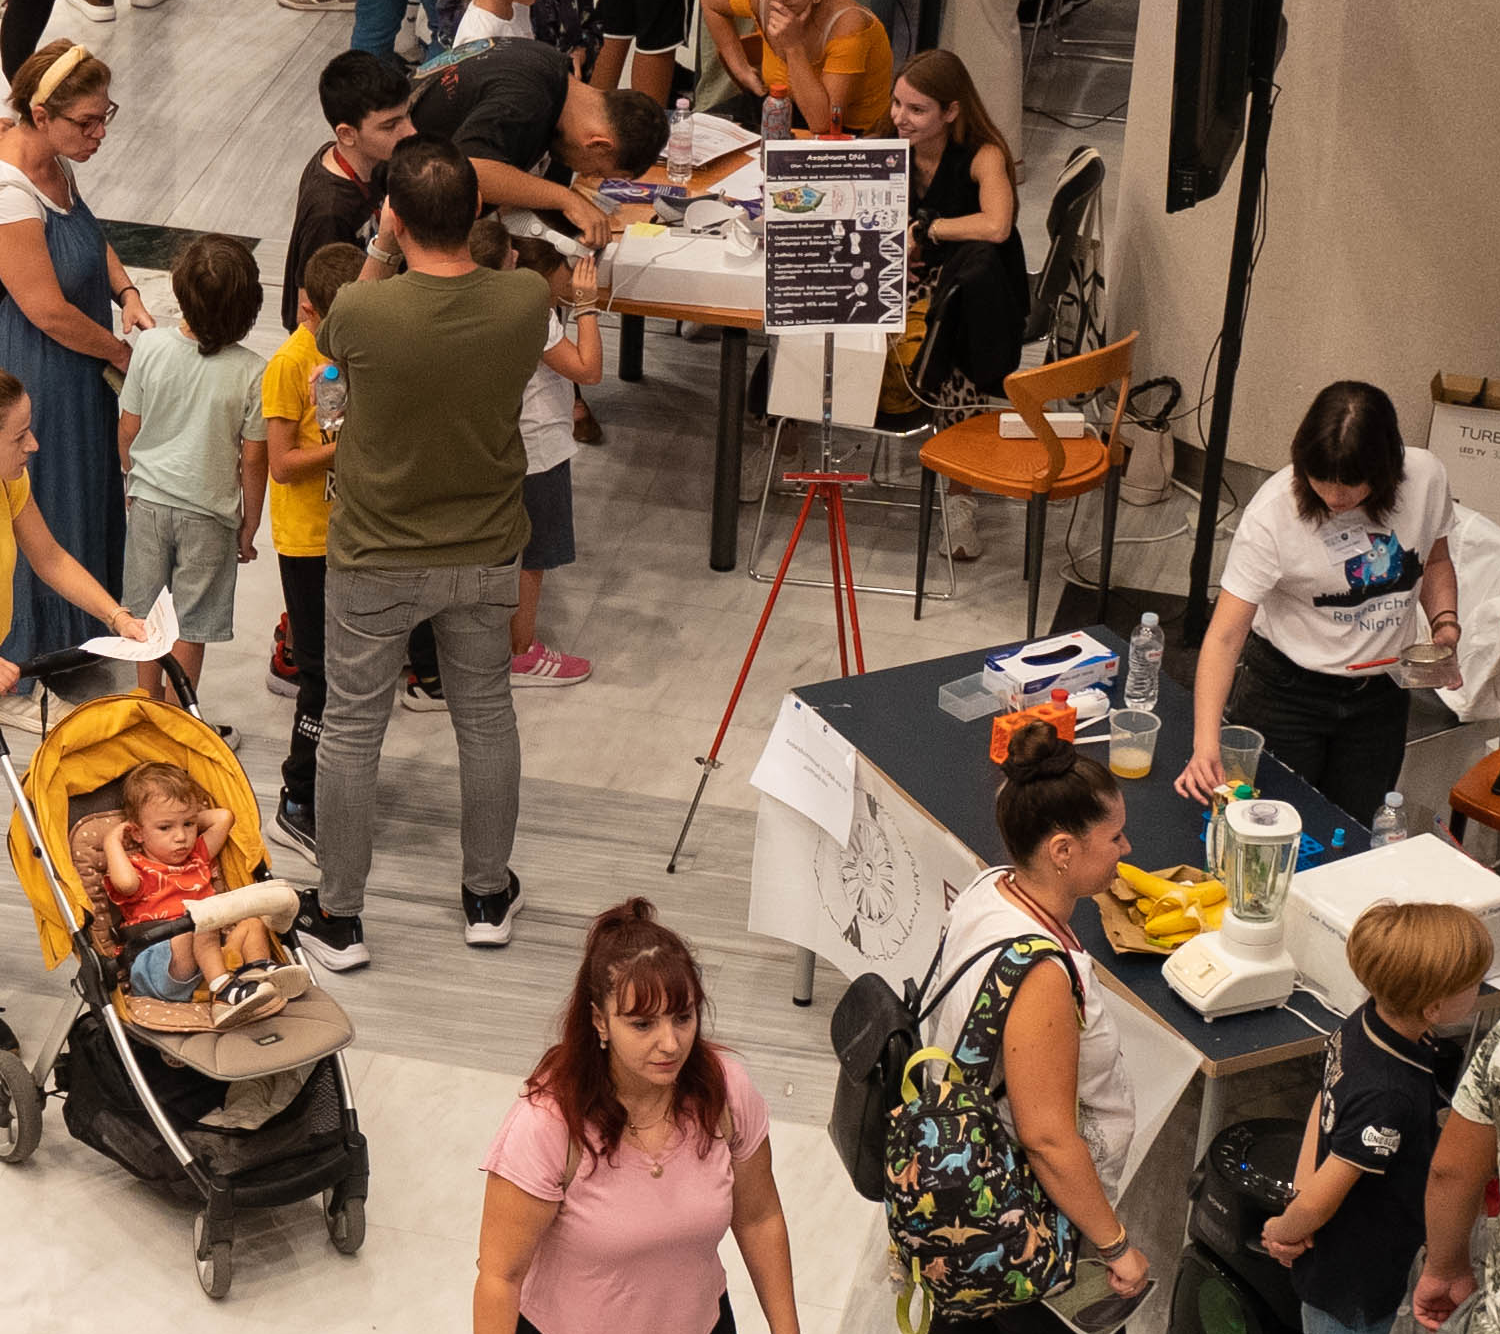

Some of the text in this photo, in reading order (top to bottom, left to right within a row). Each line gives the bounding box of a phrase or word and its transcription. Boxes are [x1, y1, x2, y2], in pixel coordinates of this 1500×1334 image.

[1459, 446, 1474, 455] LED
[1476, 447, 1486, 457] TV
[1359, 616, 1402, 634] Night
